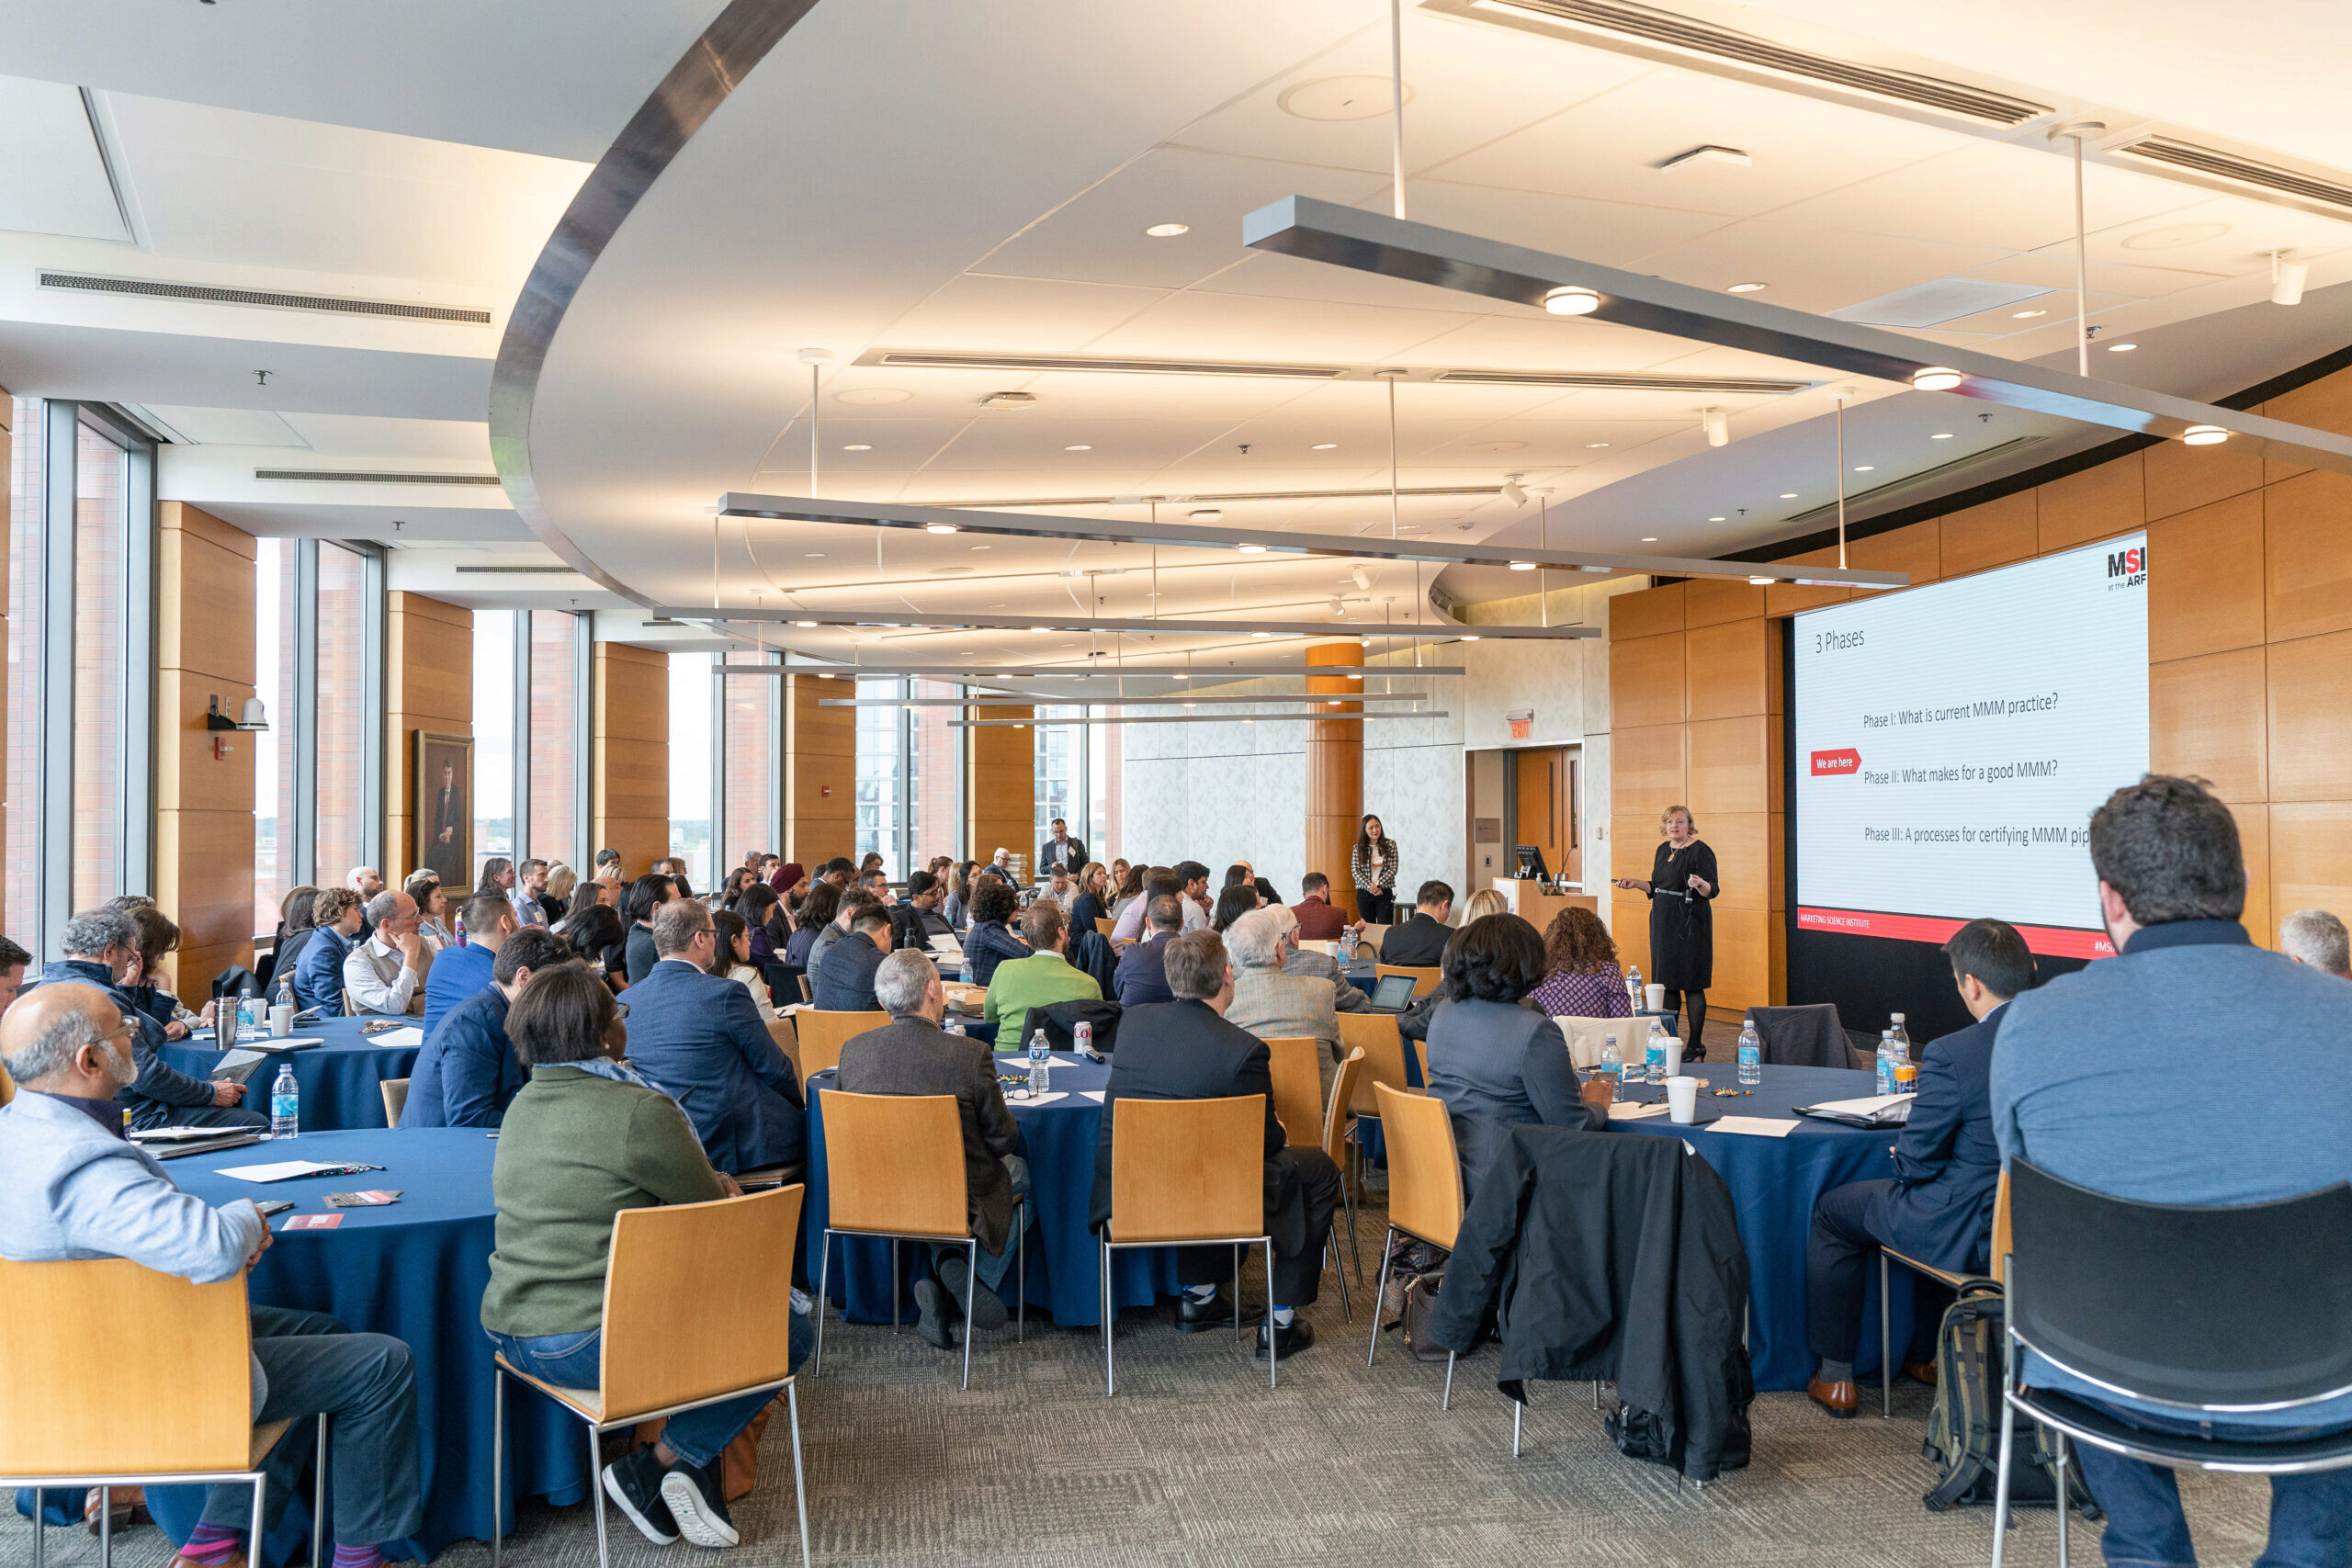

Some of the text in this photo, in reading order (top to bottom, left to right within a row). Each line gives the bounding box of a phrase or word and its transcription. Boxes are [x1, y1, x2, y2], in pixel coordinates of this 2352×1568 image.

[2109, 547, 2145, 578] MSI
[2127, 573, 2146, 588] ARF
[1815, 630, 1865, 654] 3 Phases
[1863, 692, 2059, 728] Phase I: What is current MMM practice?
[1816, 756, 1853, 769] We are here
[1864, 759, 2058, 784] Phase II: What makes for a good MMM?
[1865, 826, 2090, 847] Phase III: A processes for certifying MMM pip
[1800, 914, 1870, 929] MARKETING SCIENCE INSTITUTE
[2095, 941, 2116, 953] #MSI
